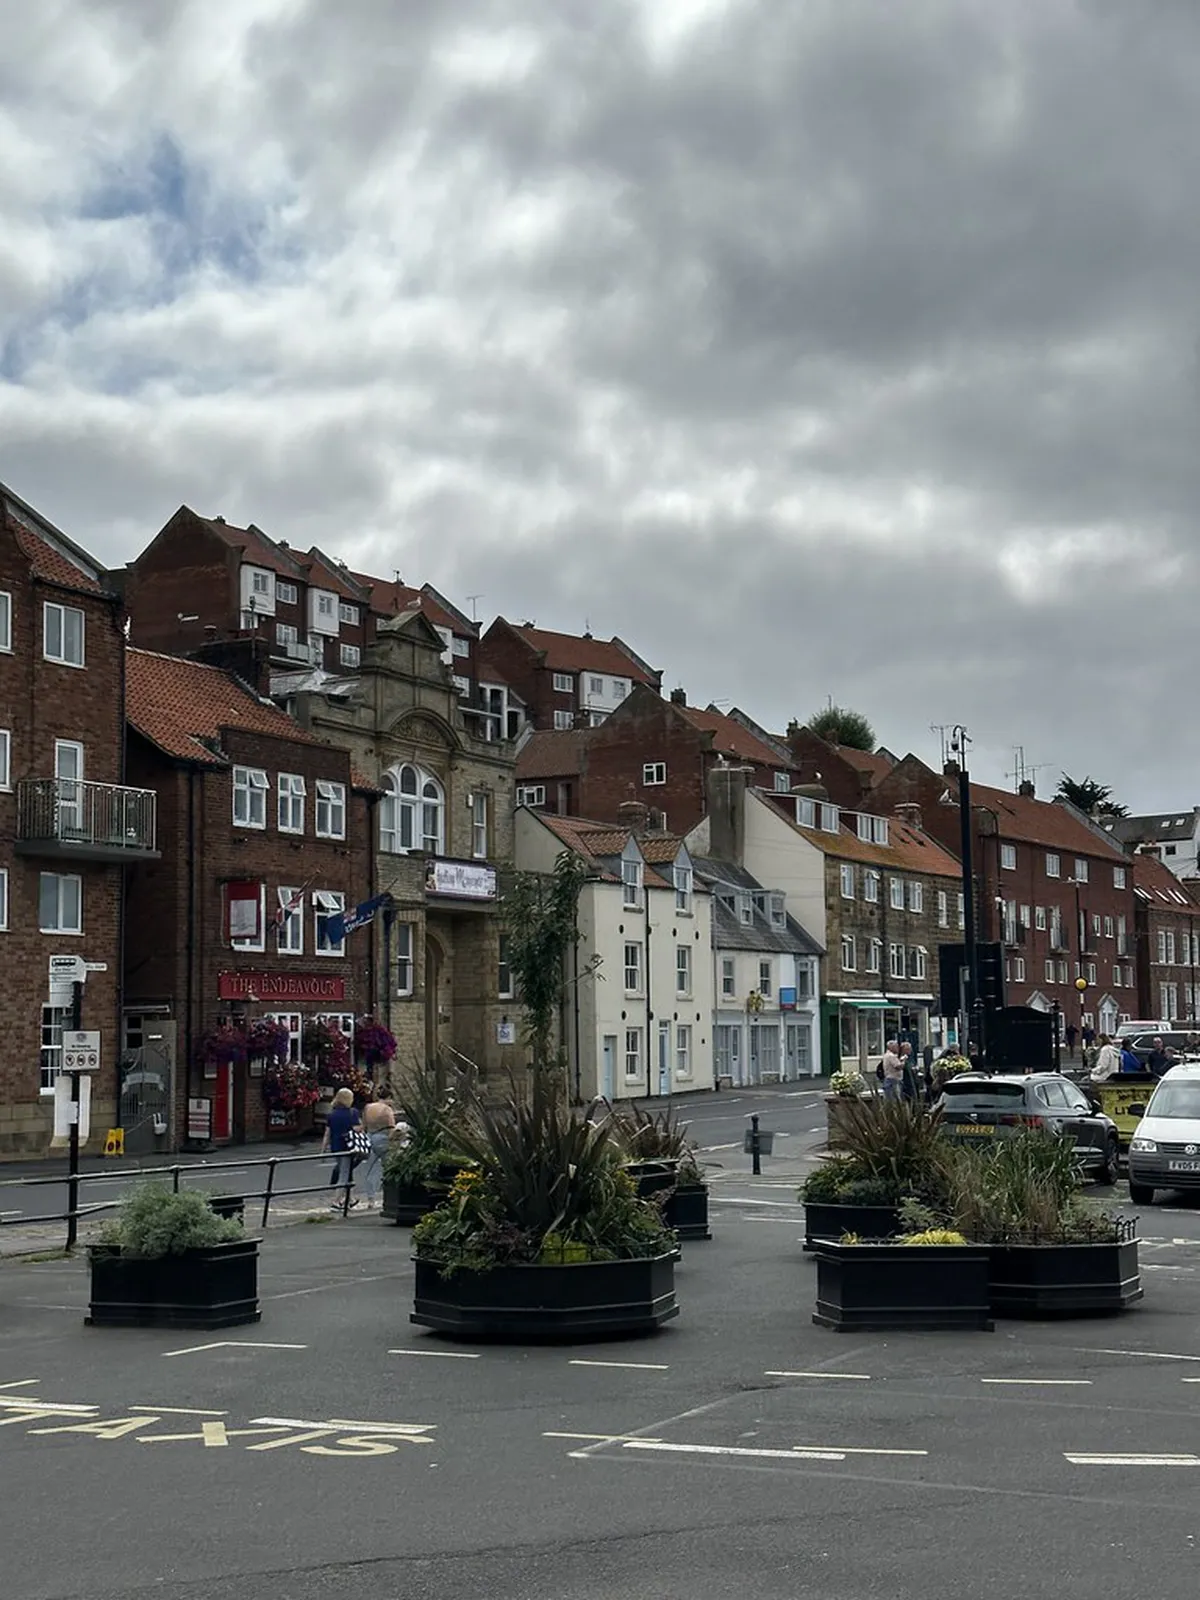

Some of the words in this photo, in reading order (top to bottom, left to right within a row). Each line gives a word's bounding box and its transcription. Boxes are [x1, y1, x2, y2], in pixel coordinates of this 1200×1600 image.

[230, 977, 258, 993] THE
[261, 977, 336, 995] ENDEAVOUR
[0, 1407, 436, 1457] TAXIS
